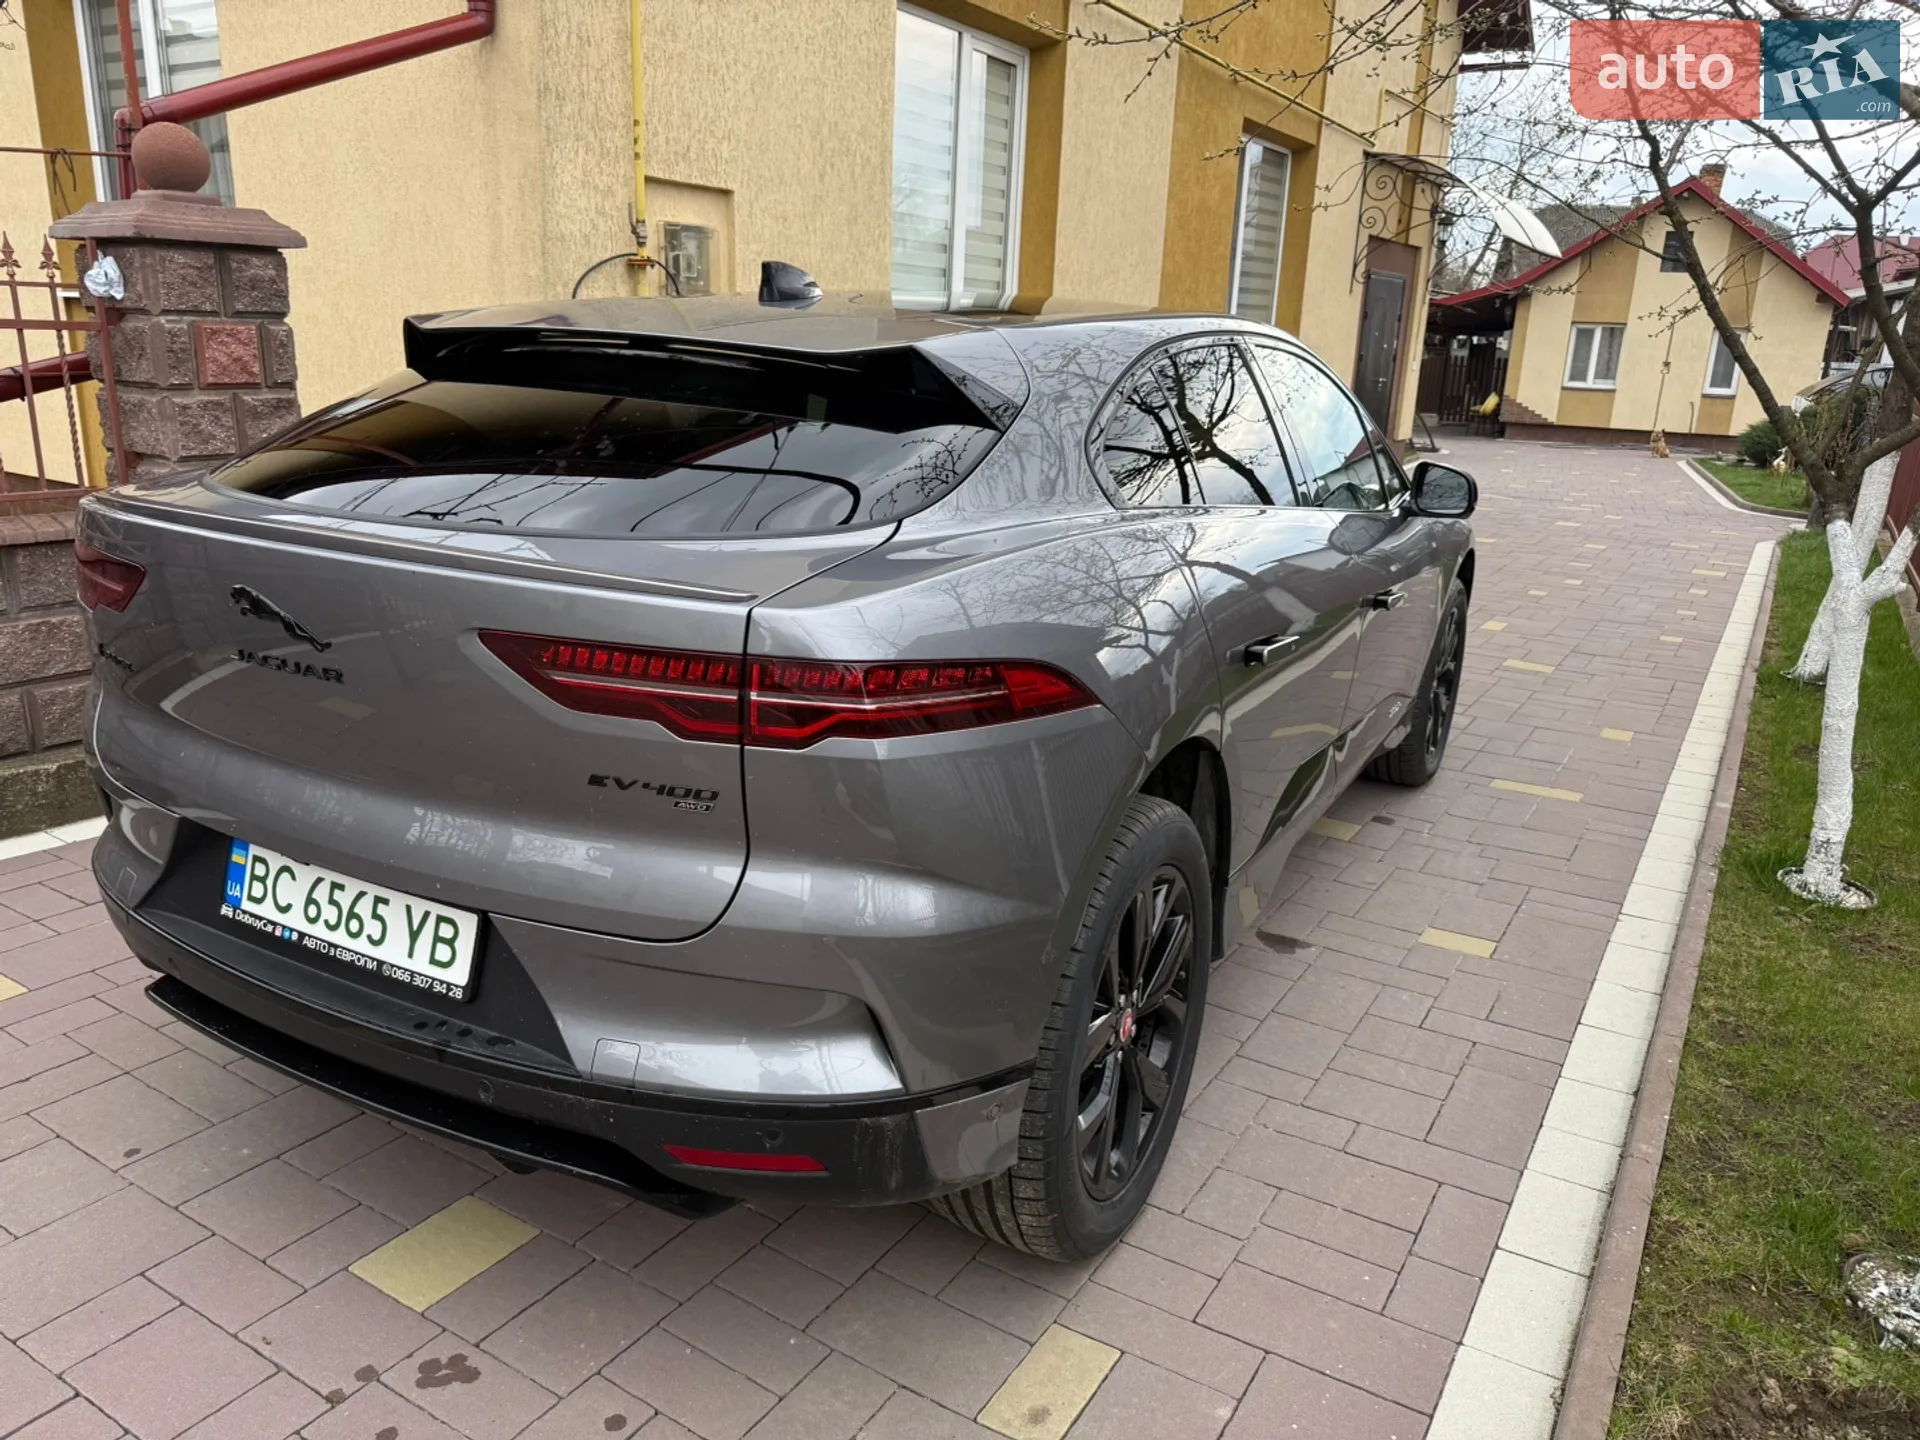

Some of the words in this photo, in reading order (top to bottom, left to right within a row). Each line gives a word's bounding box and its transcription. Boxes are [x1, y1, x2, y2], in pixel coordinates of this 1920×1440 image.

[230, 649, 345, 684] JAGUAR
[587, 773, 719, 801] EV400
[227, 880, 242, 899] UA
[234, 909, 274, 934] DobruyCar
[246, 854, 297, 915] BC
[303, 876, 390, 947] 6565
[405, 904, 460, 969] YB
[302, 936, 329, 954] АВТО
[336, 947, 378, 971] ЄВРОПИ
[391, 967, 411, 983] 066
[412, 974, 432, 989] 307
[432, 981, 447, 994] 94
[448, 985, 463, 999] 28
